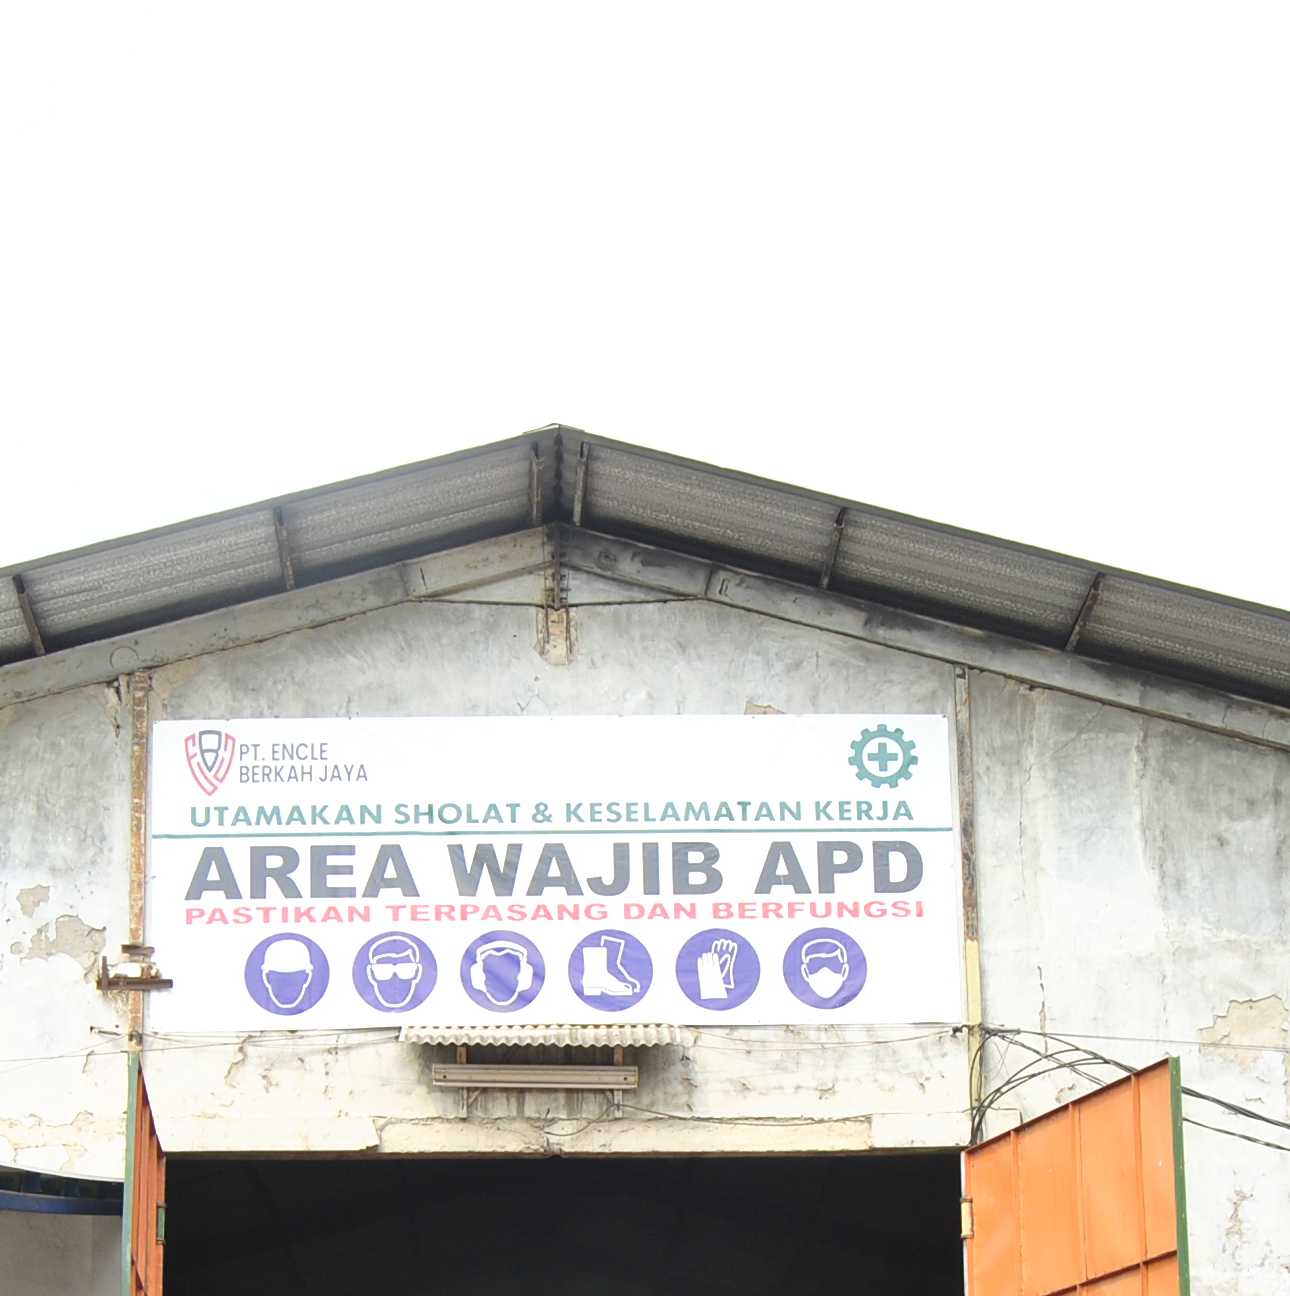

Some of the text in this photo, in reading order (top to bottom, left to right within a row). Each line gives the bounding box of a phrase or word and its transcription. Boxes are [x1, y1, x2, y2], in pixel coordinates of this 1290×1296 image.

[239, 742, 328, 762] PT. ENCLE
[239, 763, 369, 784] BERKAH JAYA
[190, 799, 915, 828] UTAMAKAN SHOLAT & KESELAMATAN KERJA
[184, 840, 924, 901] AREA WAJIB APD
[184, 900, 925, 926] PASTIKAN TERPASANG DAN BERFUNGSI
